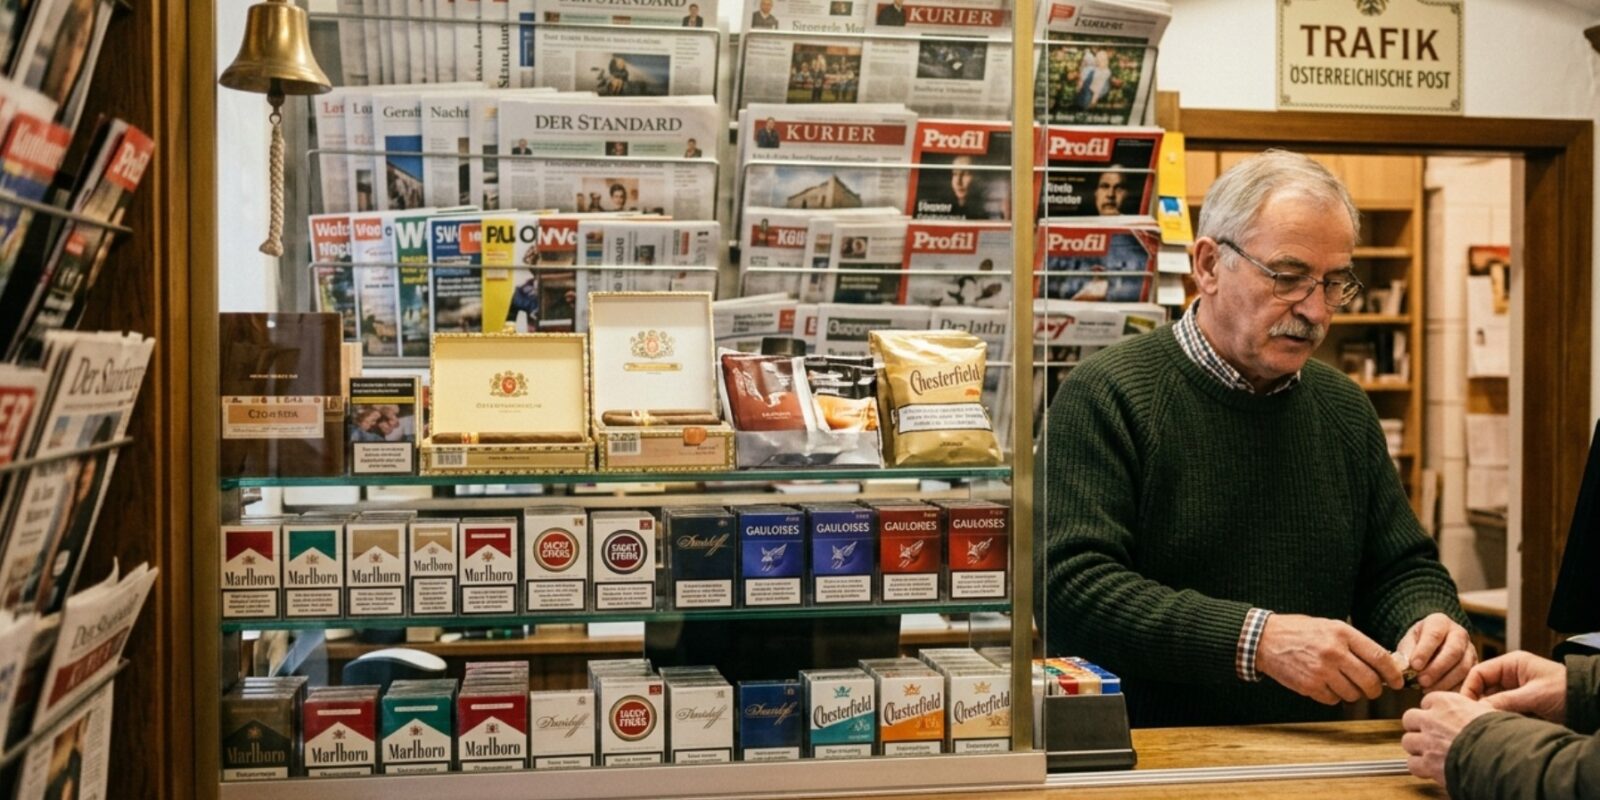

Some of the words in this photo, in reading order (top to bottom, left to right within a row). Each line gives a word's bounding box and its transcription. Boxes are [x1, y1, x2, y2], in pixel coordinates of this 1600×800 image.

[909, 6, 994, 25] KURIER
[1300, 24, 1439, 61] TRAFIK
[1417, 70, 1450, 89] POST
[535, 114, 573, 130] DER
[578, 114, 683, 132] STANDARD
[786, 124, 876, 143] KURIER
[922, 128, 985, 150] Profil
[1049, 136, 1110, 156] Profil
[912, 232, 975, 251] Profil
[1047, 234, 1106, 251] Profil
[910, 363, 981, 396] Chesterfield
[746, 524, 799, 536] GAULOISES
[816, 522, 870, 534] GAULOISES
[952, 519, 1005, 529] GAULOISES
[225, 568, 275, 586] Marlboro
[288, 567, 338, 584] Marlboro
[388, 740, 445, 760] Marlboro
[465, 737, 520, 757] Marlboro
